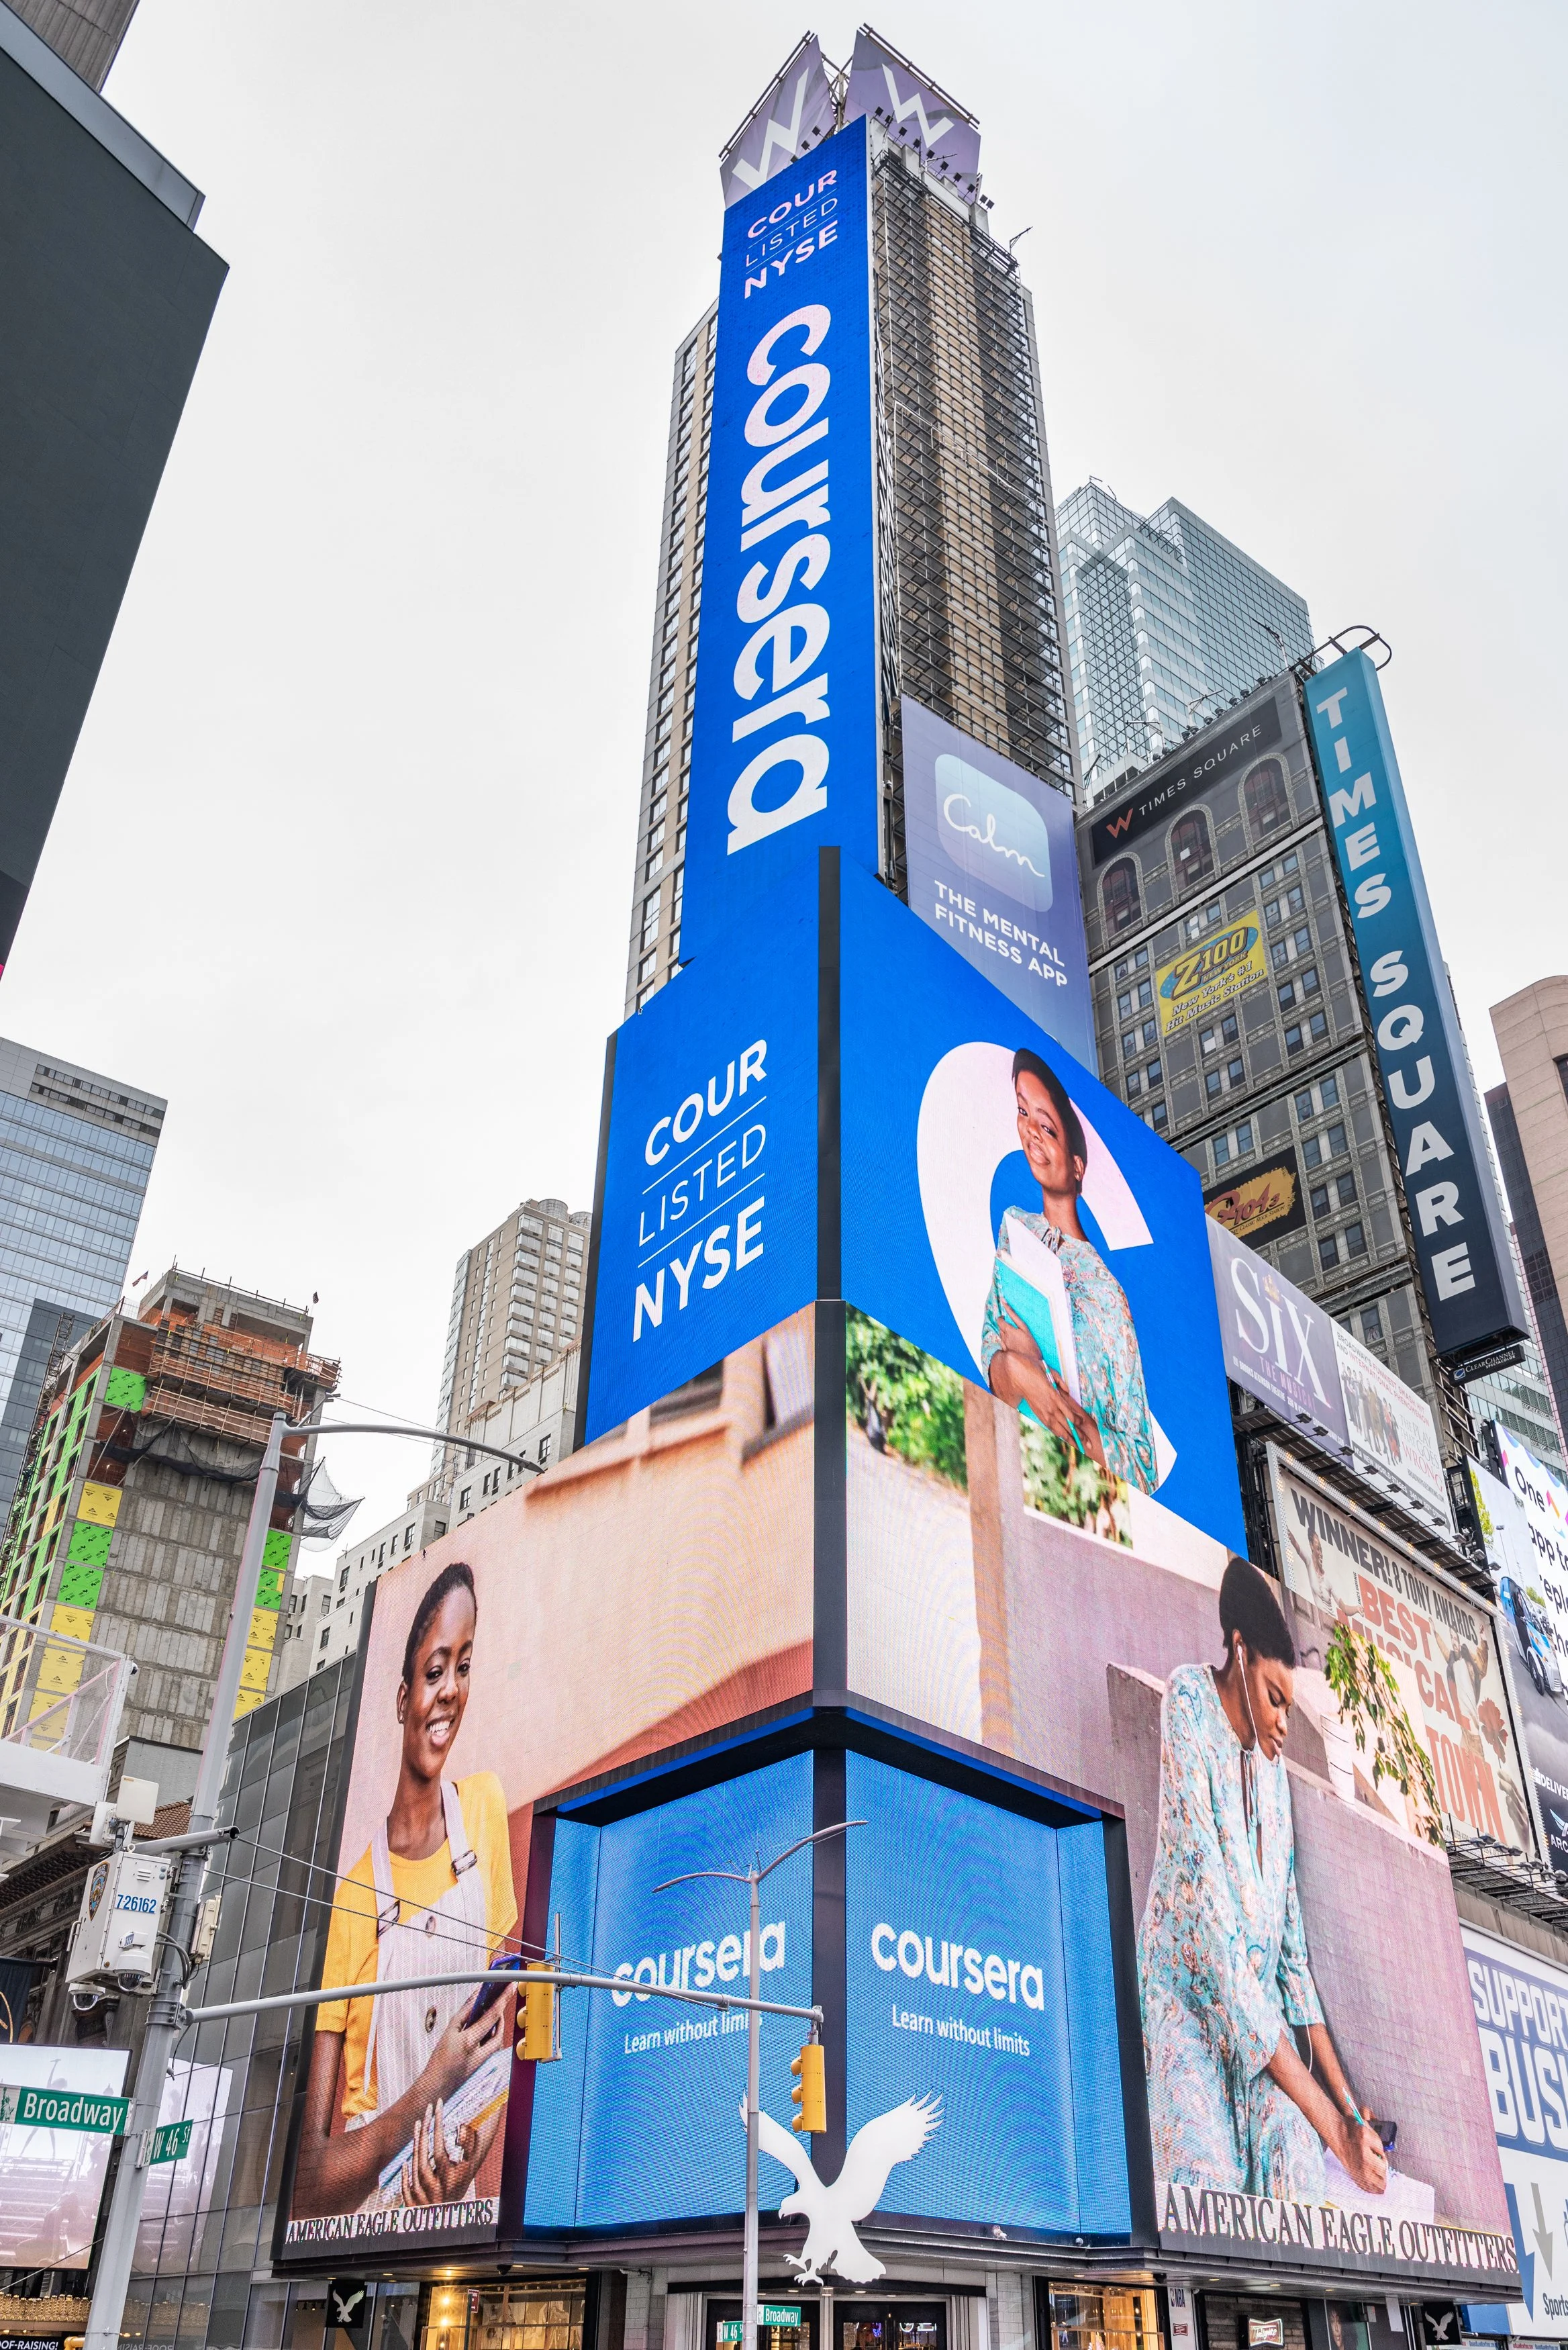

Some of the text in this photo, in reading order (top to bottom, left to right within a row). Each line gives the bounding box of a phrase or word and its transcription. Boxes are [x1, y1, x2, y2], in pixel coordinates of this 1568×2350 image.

[881, 63, 954, 148] W
[746, 197, 838, 267] LISTED
[748, 169, 837, 238] COUR
[744, 220, 838, 299] NYSE
[728, 304, 830, 855] coursera
[1107, 724, 1261, 839] W TIMES SQUARE
[1316, 687, 1391, 918] TIMES
[943, 794, 1045, 878] Calm
[934, 880, 1065, 967] THE MENTAL
[935, 903, 1067, 987] FITNESS APP
[1171, 927, 1248, 1000] Z100
[1172, 961, 1253, 1017] New York's #1
[1202, 951, 1249, 984] NEW YORK
[1166, 969, 1263, 1032] Hit Music Station
[644, 1039, 767, 1166] COUR
[1371, 951, 1475, 1301] SQUARE
[639, 1123, 766, 1247] LISTED
[633, 1196, 764, 1343] NYSE
[1231, 1258, 1331, 1409] SIX
[1336, 1331, 1371, 1367] BROADWAY'S
[1485, 1354, 1516, 1368] SPECTACOLOR
[1259, 1356, 1317, 1413] THE MUSICAL
[1336, 1343, 1349, 1356] AND
[1349, 1350, 1393, 1397] INTERNATIONAL
[1402, 1440, 1443, 1493] WRONG
[1514, 1466, 1546, 1513] One
[1291, 1488, 1479, 1646] WINNER! 8 TONY AWARDS
[1357, 1574, 1432, 1661] BEST
[871, 1922, 1044, 2011] coursera
[624, 2033, 660, 2055] Learn
[664, 2018, 718, 2047] without
[892, 2004, 1030, 2056] Learn without limits
[23, 2092, 124, 2134] Broadway
[153, 2124, 191, 2159] W 46 St
[285, 2199, 494, 2244] AMERICAN EAGLE OUTFITTERS
[1163, 2185, 1519, 2273] AMERICAN EAGLE OUTFITTERS
[765, 2307, 799, 2324] Broadway
[1175, 2288, 1186, 2308] NBA
[723, 2327, 730, 2341] W
[730, 2326, 738, 2340] 46
